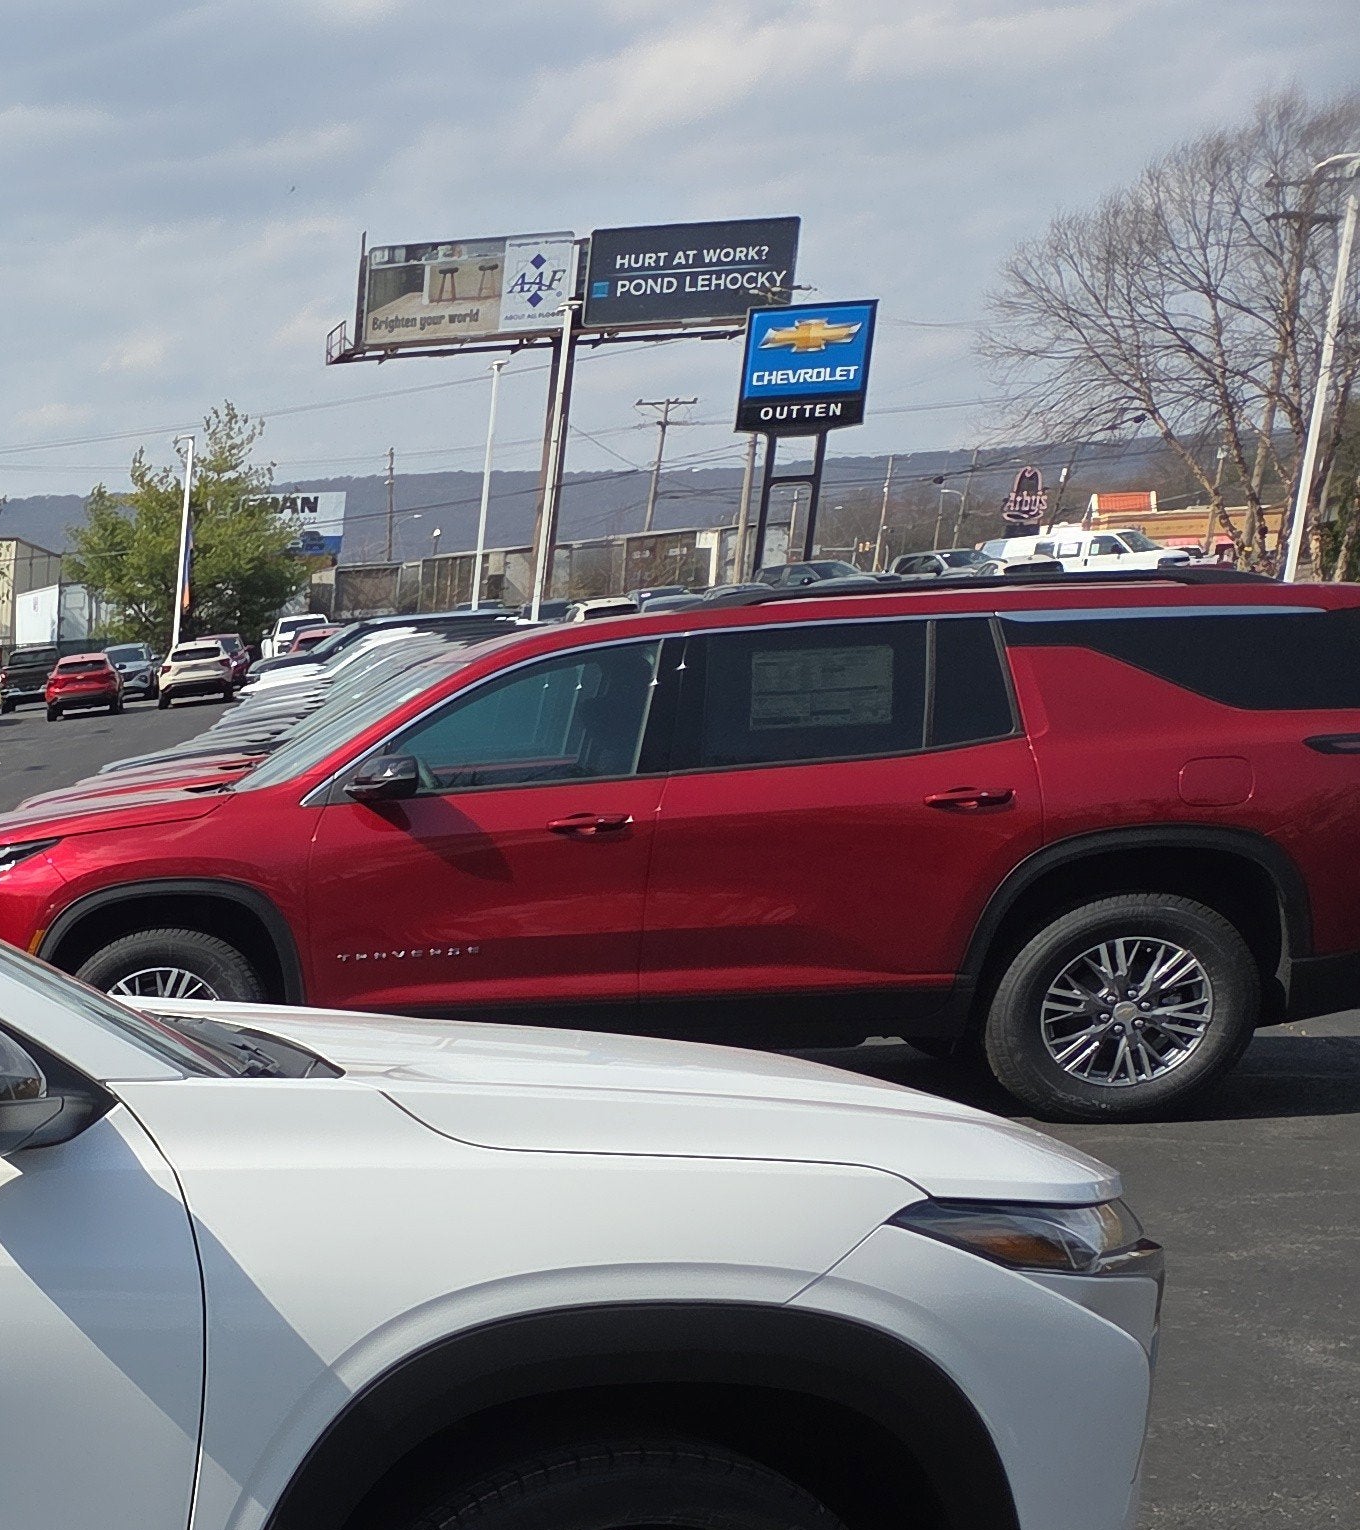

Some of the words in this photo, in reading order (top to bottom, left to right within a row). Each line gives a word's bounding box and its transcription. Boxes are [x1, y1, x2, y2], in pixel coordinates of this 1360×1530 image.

[615, 252, 668, 269] HURT
[673, 250, 697, 265] AT
[703, 245, 769, 263] WORK?
[616, 276, 677, 297] POND
[684, 270, 787, 292] LEHOCKY
[372, 315, 418, 333] Brighten
[419, 315, 445, 332] your
[448, 308, 480, 324] world
[752, 366, 859, 386] CHEVROLET
[760, 402, 842, 420] OUTTEN
